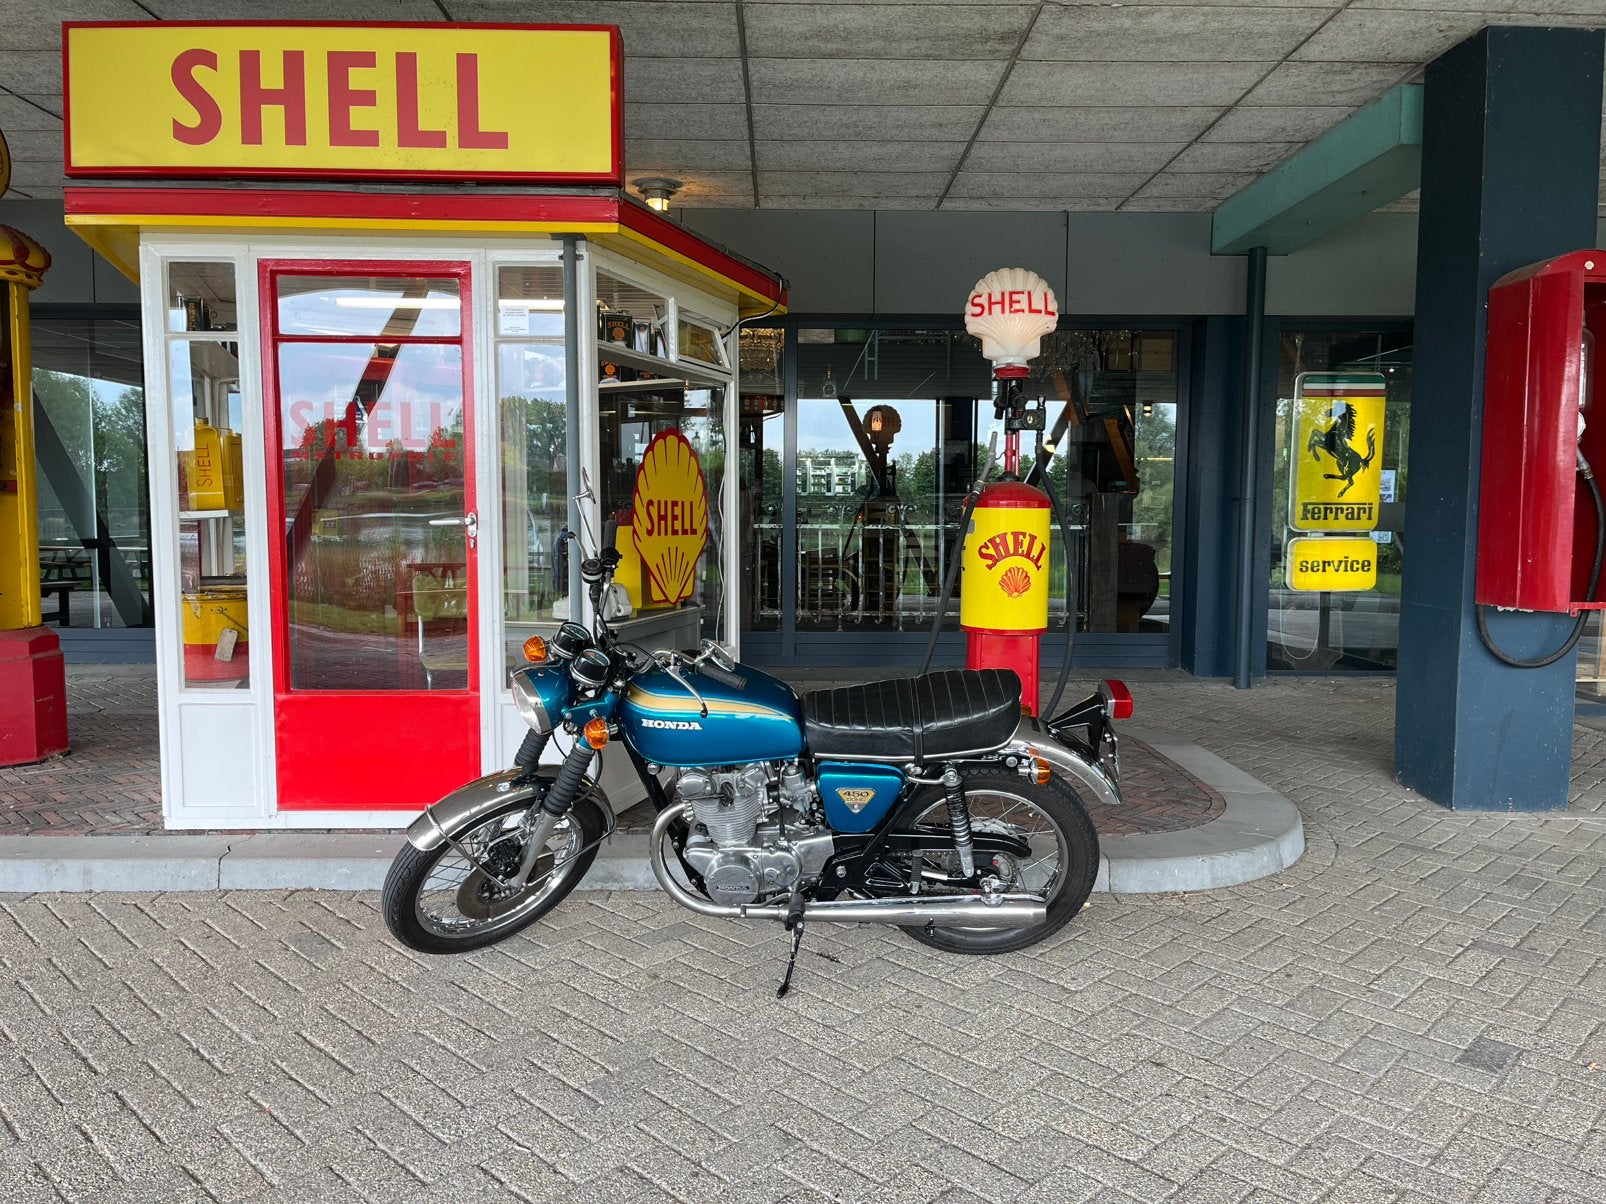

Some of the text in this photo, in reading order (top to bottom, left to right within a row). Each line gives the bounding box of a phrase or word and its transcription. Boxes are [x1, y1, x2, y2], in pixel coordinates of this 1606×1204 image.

[170, 47, 509, 150] SHELL
[970, 289, 1056, 318] SHELL
[289, 400, 457, 449] SHELL
[195, 443, 213, 487] SHELL
[645, 498, 698, 537] SHELL
[1300, 501, 1374, 521] Ferrari
[977, 530, 1047, 571] SHELL
[1299, 555, 1372, 573] service
[641, 718, 703, 731] HONDA
